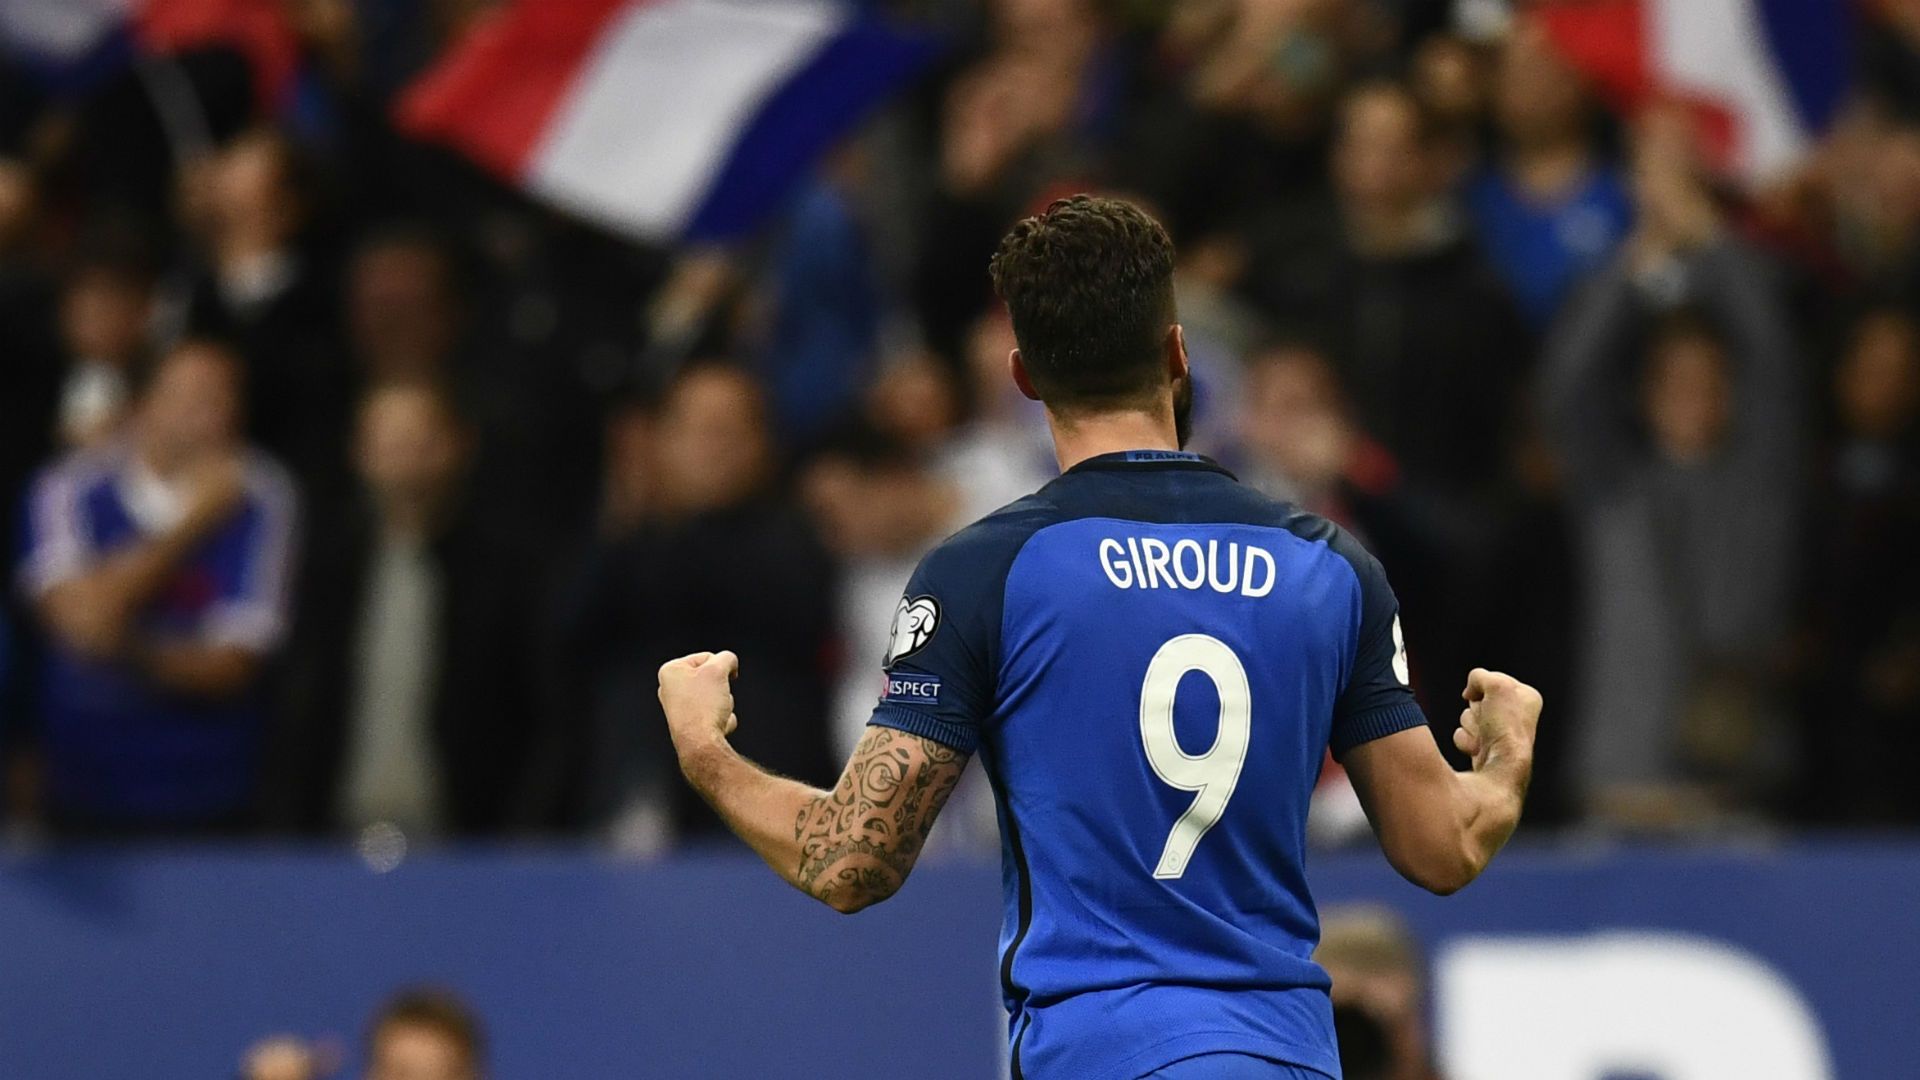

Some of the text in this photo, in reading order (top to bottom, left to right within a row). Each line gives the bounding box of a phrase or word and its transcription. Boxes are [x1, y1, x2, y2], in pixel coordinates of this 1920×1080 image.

[1099, 537, 1275, 598] GIROUD
[889, 680, 941, 697] ESPECT
[1140, 633, 1251, 880] 9
